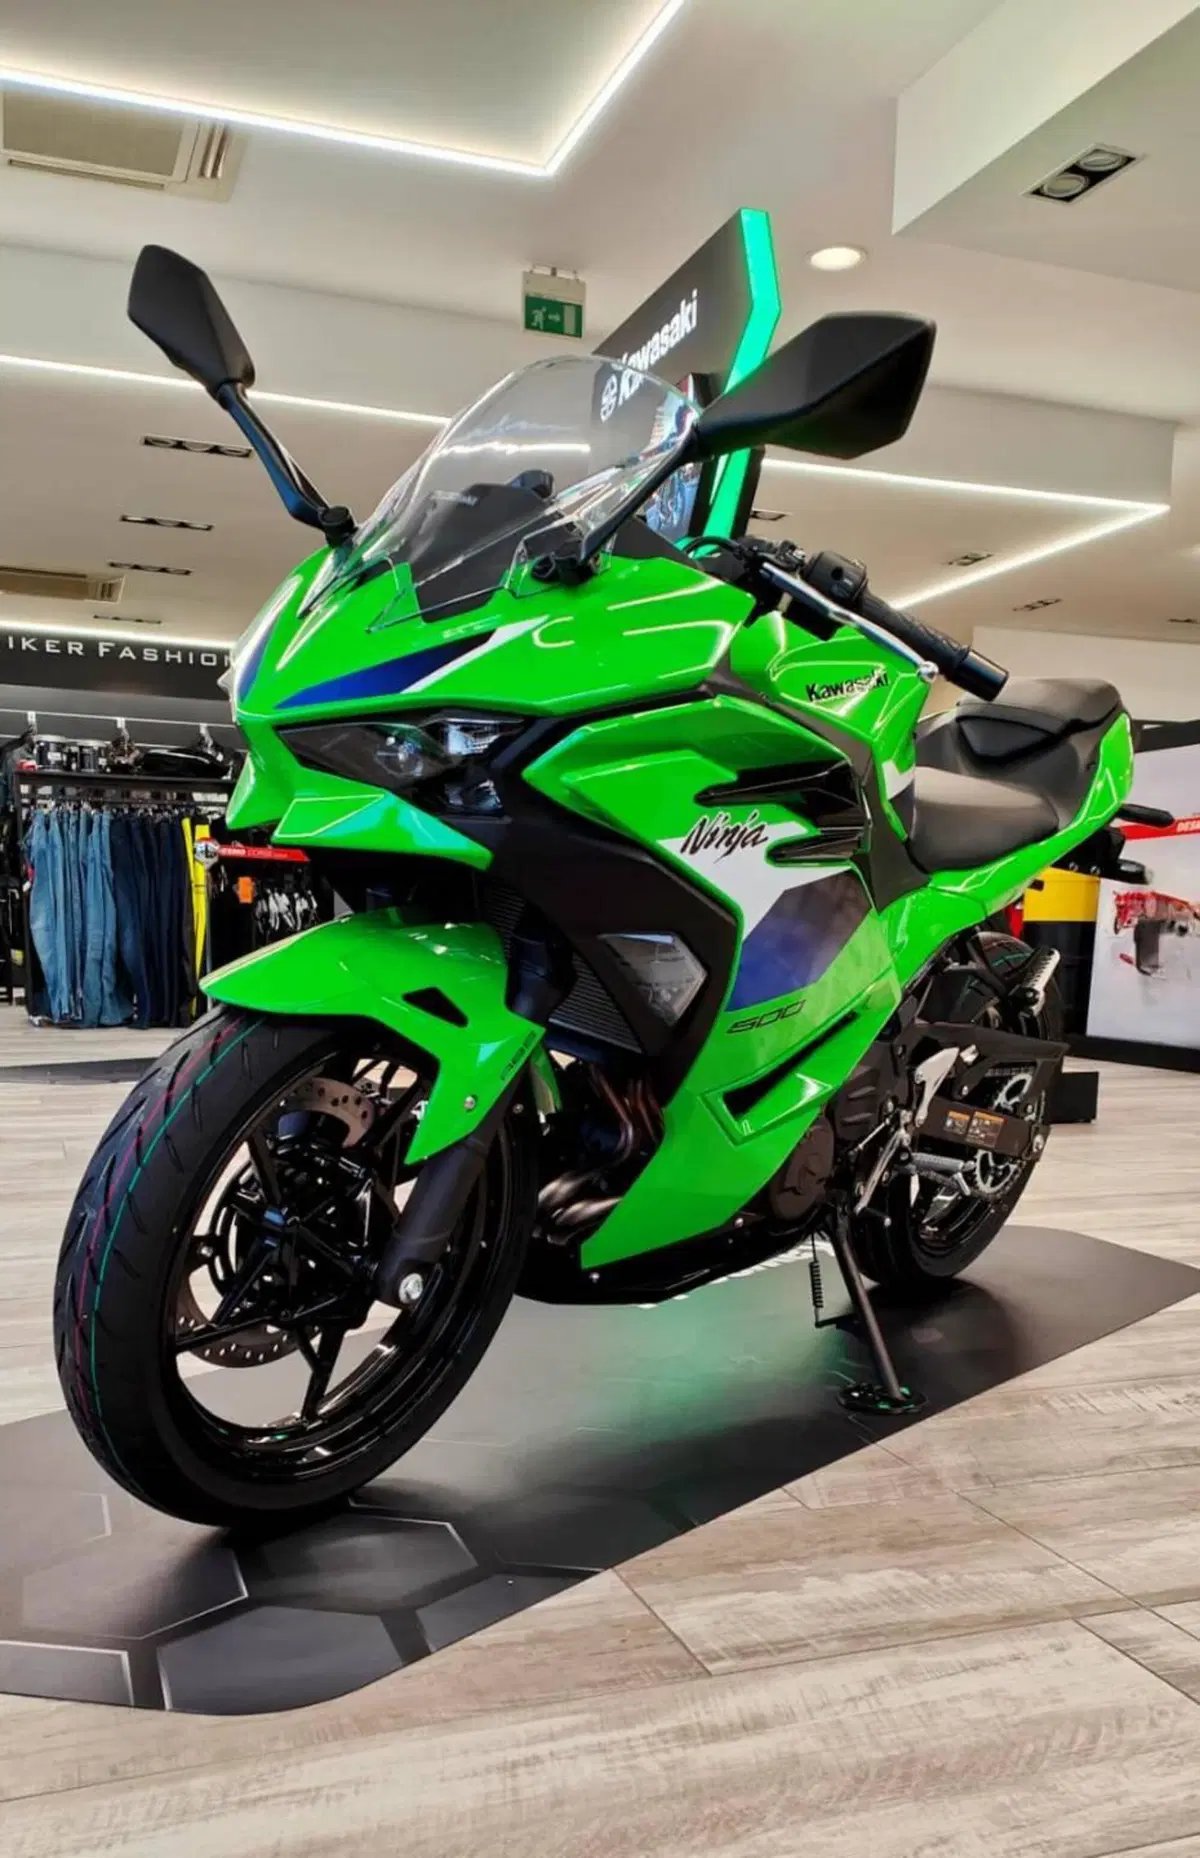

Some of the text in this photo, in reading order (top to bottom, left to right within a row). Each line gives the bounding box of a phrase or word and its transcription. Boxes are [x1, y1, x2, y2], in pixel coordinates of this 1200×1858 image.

[618, 288, 698, 407] Kawasaki
[805, 669, 889, 702] Kawasaki
[680, 810, 769, 864] Ninja
[725, 999, 807, 1034] 500
